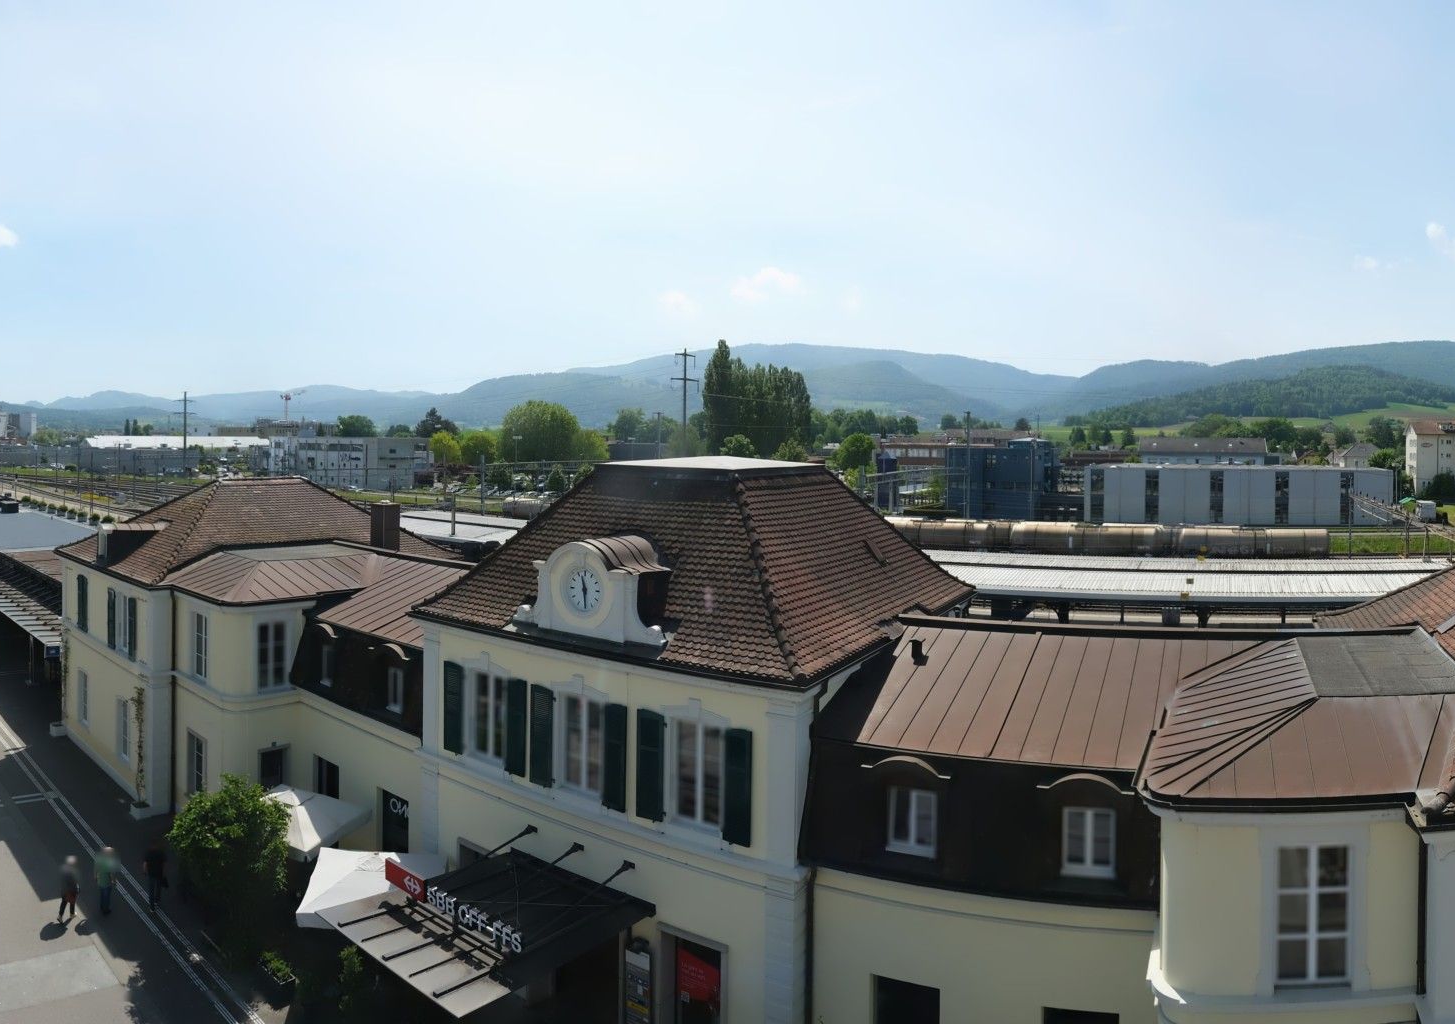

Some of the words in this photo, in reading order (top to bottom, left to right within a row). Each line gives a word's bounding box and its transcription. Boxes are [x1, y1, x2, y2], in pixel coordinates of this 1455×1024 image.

[427, 886, 456, 917] SBB
[458, 905, 488, 932] CFF
[492, 920, 522, 953] FFS
